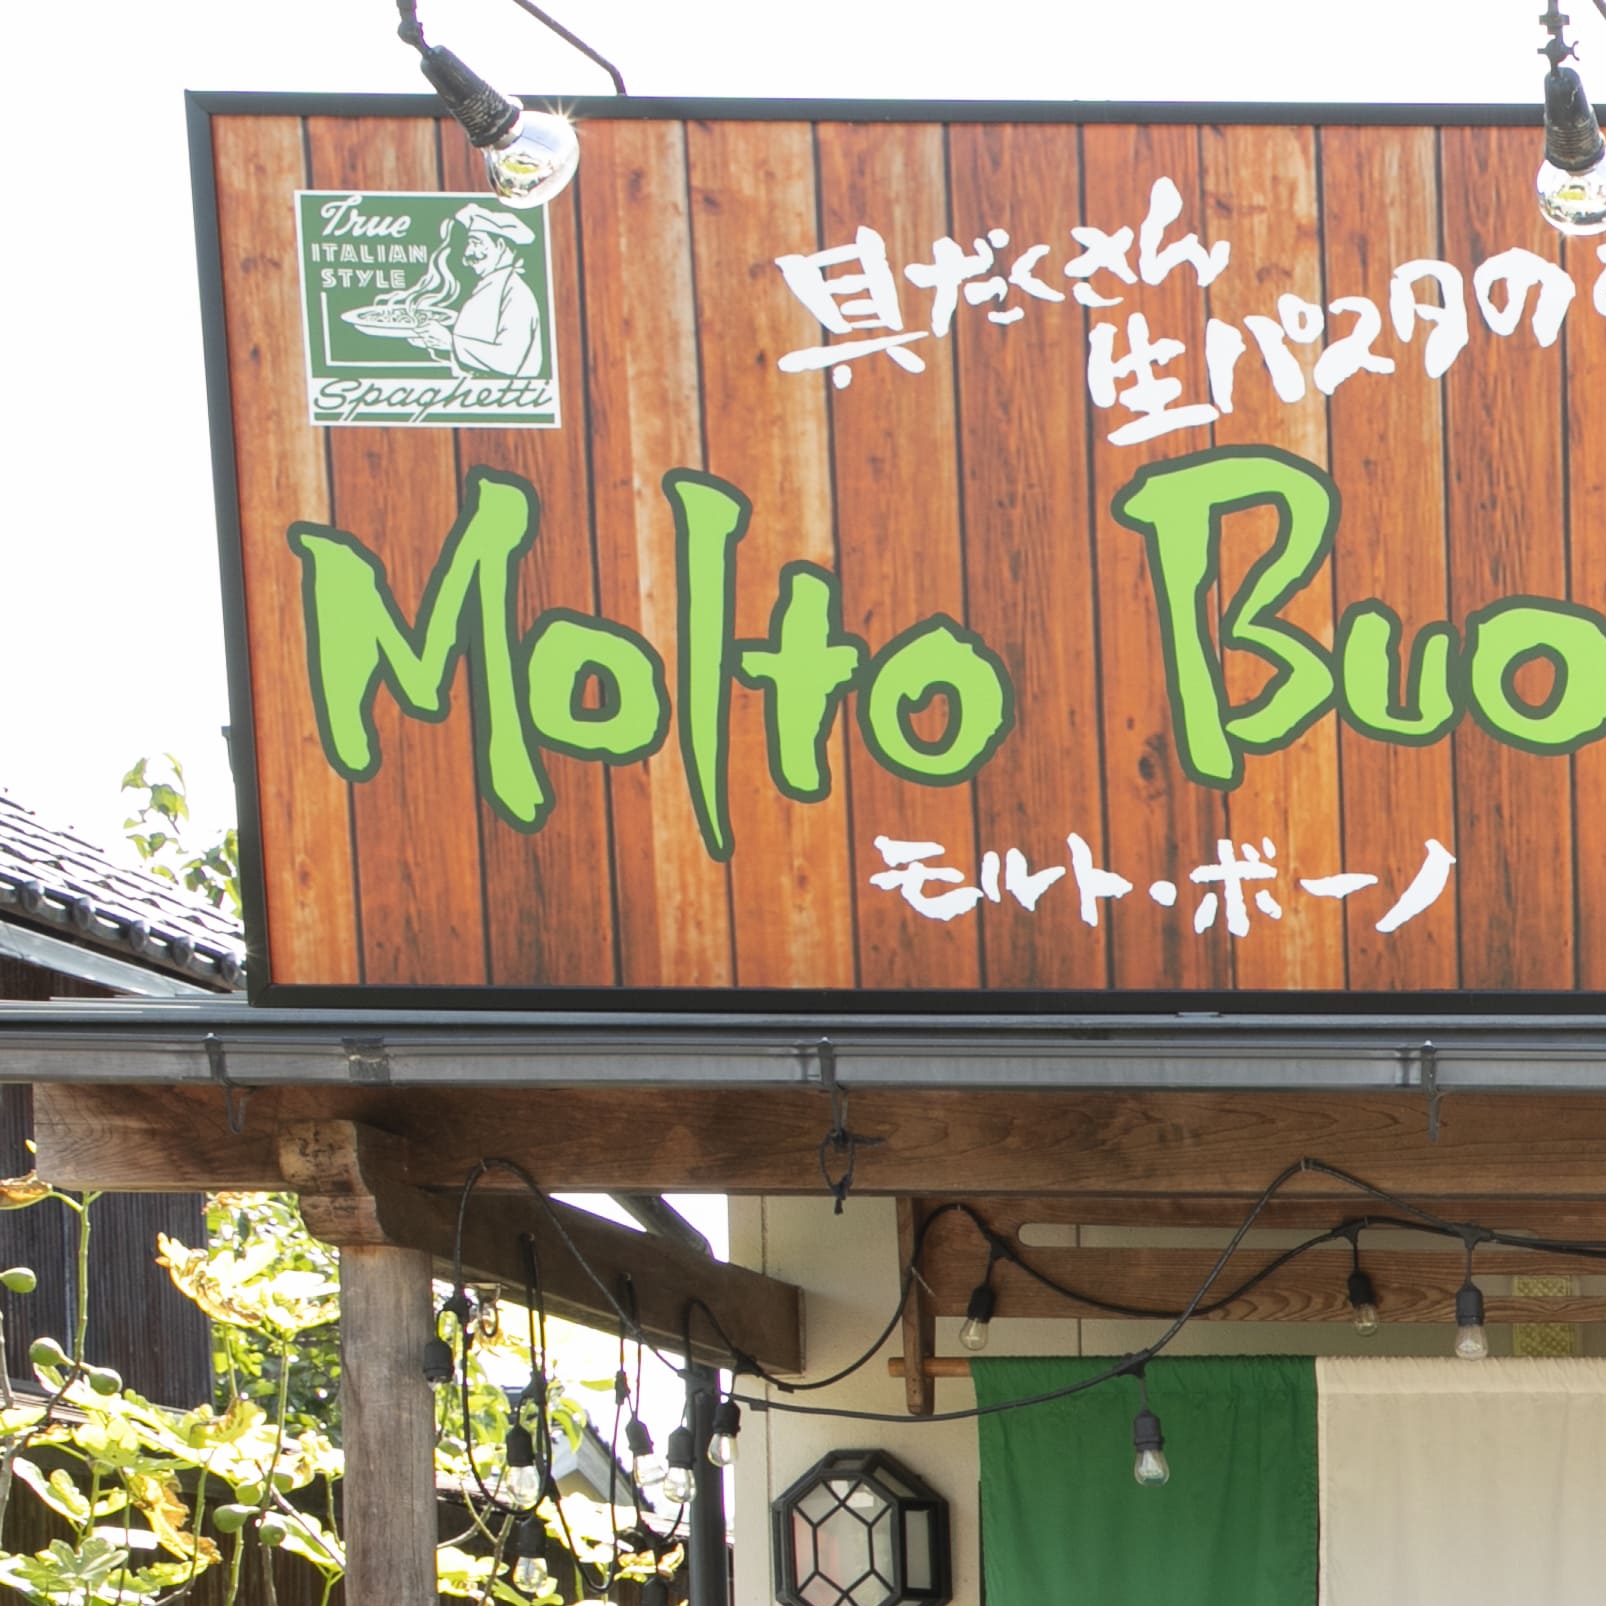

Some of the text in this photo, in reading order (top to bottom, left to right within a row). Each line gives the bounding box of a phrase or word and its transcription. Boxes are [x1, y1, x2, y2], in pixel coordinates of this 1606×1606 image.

[320, 195, 412, 238] True
[311, 243, 428, 264] ITALIAN
[320, 268, 406, 289] STYLE
[776, 176, 1230, 389] 具だくさん
[313, 375, 553, 421] Spaghetti
[288, 463, 1014, 861] Molto
[869, 832, 1457, 938] モルト・ボーノ
